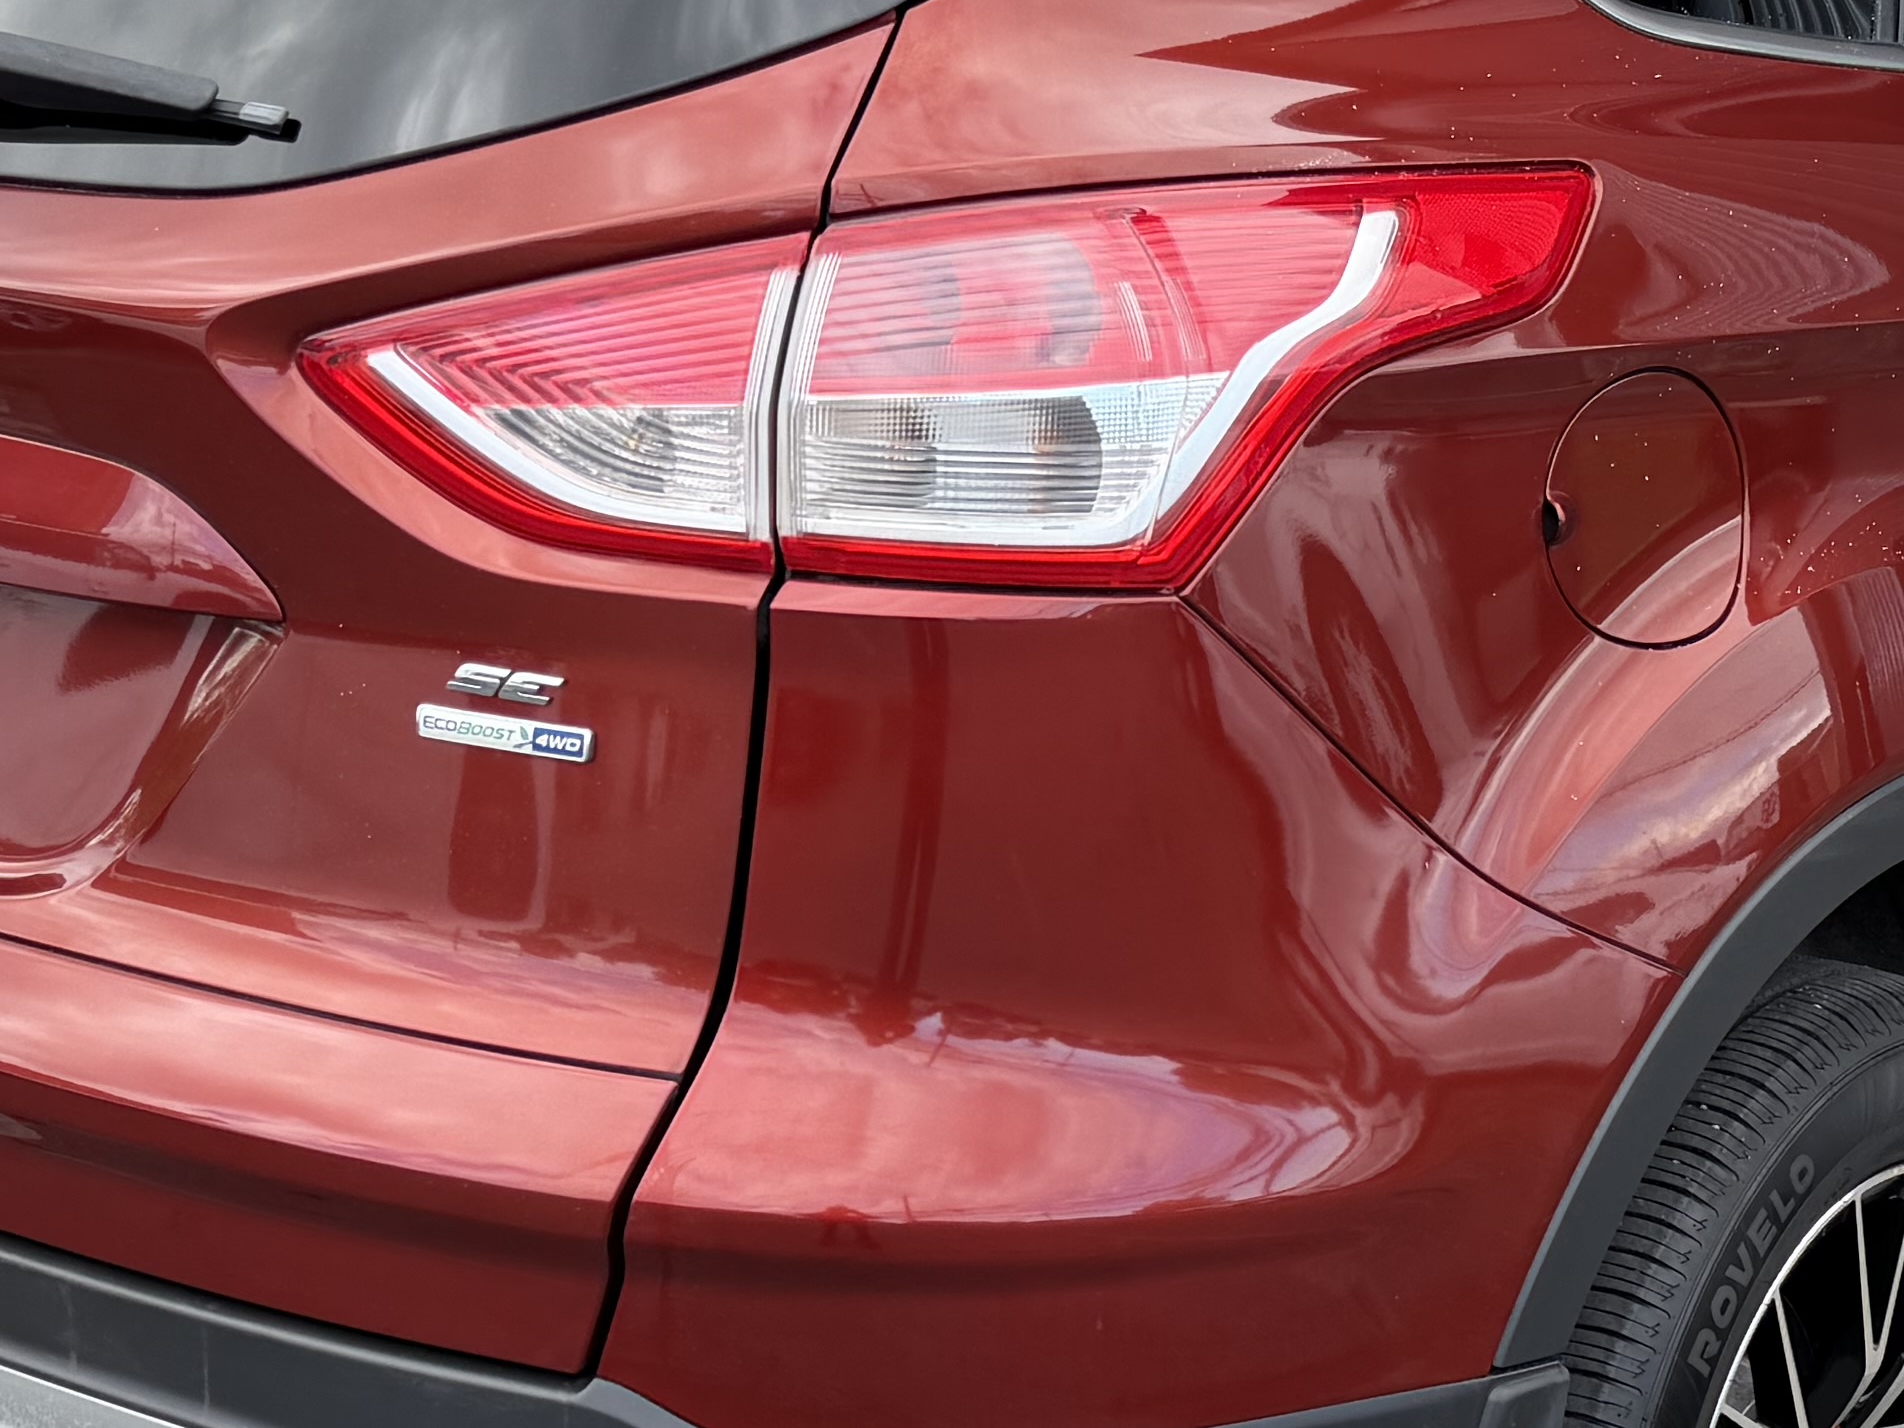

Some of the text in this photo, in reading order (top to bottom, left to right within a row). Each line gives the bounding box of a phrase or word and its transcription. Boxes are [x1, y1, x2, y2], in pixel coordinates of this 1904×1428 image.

[446, 662, 565, 706] SE
[422, 714, 582, 753] ECOBOOST 4WD
[1686, 1153, 1815, 1378] ROVELO
